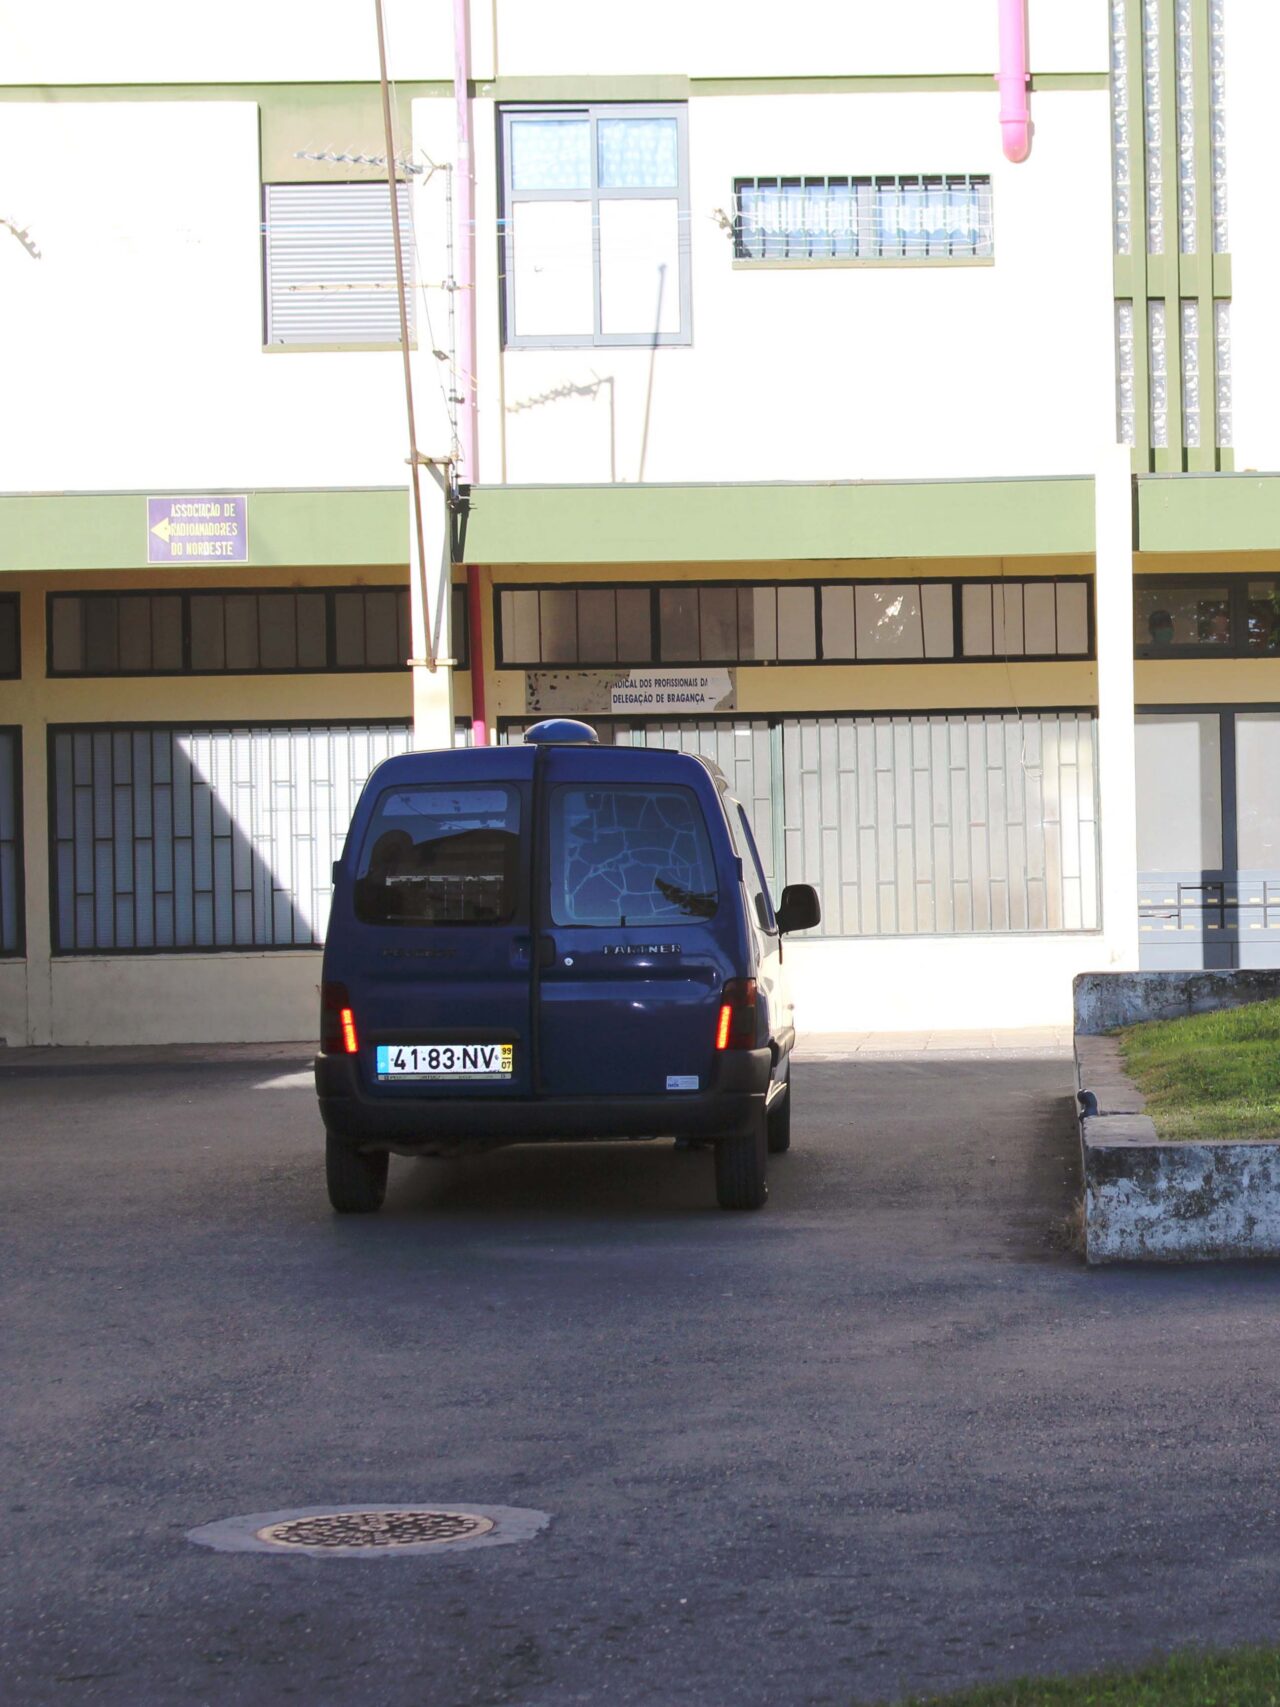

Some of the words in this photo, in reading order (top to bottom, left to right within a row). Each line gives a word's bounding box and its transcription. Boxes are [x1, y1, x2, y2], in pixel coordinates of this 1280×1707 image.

[171, 502, 220, 518] ASSOCIAÇÃO
[224, 503, 236, 517] DE
[171, 542, 182, 555] DO
[186, 541, 234, 555] NORDESTE
[640, 678, 652, 688] DOS
[654, 678, 697, 687] PROFISSIONAIS
[613, 691, 653, 705] DELEGAÇÃO
[656, 694, 664, 702] DE
[667, 693, 705, 705] BRAGANÇA
[502, 1048, 512, 1056] 99
